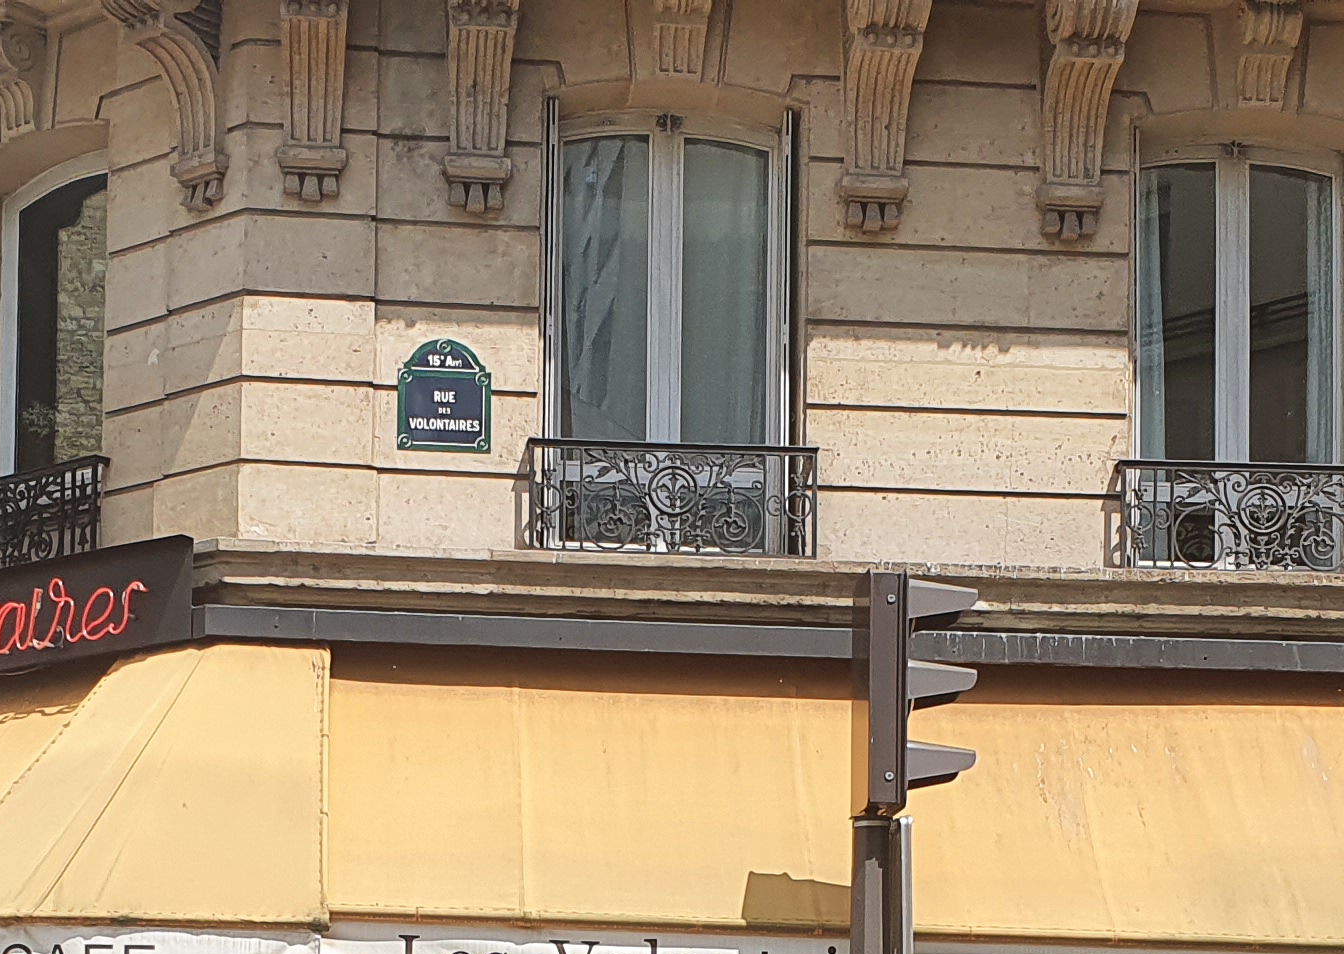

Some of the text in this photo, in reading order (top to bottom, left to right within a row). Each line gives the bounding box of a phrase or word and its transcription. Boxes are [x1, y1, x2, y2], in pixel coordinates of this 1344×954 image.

[433, 390, 456, 403] RUE
[438, 406, 451, 415] DES
[408, 417, 480, 432] VOLONTAIRES
